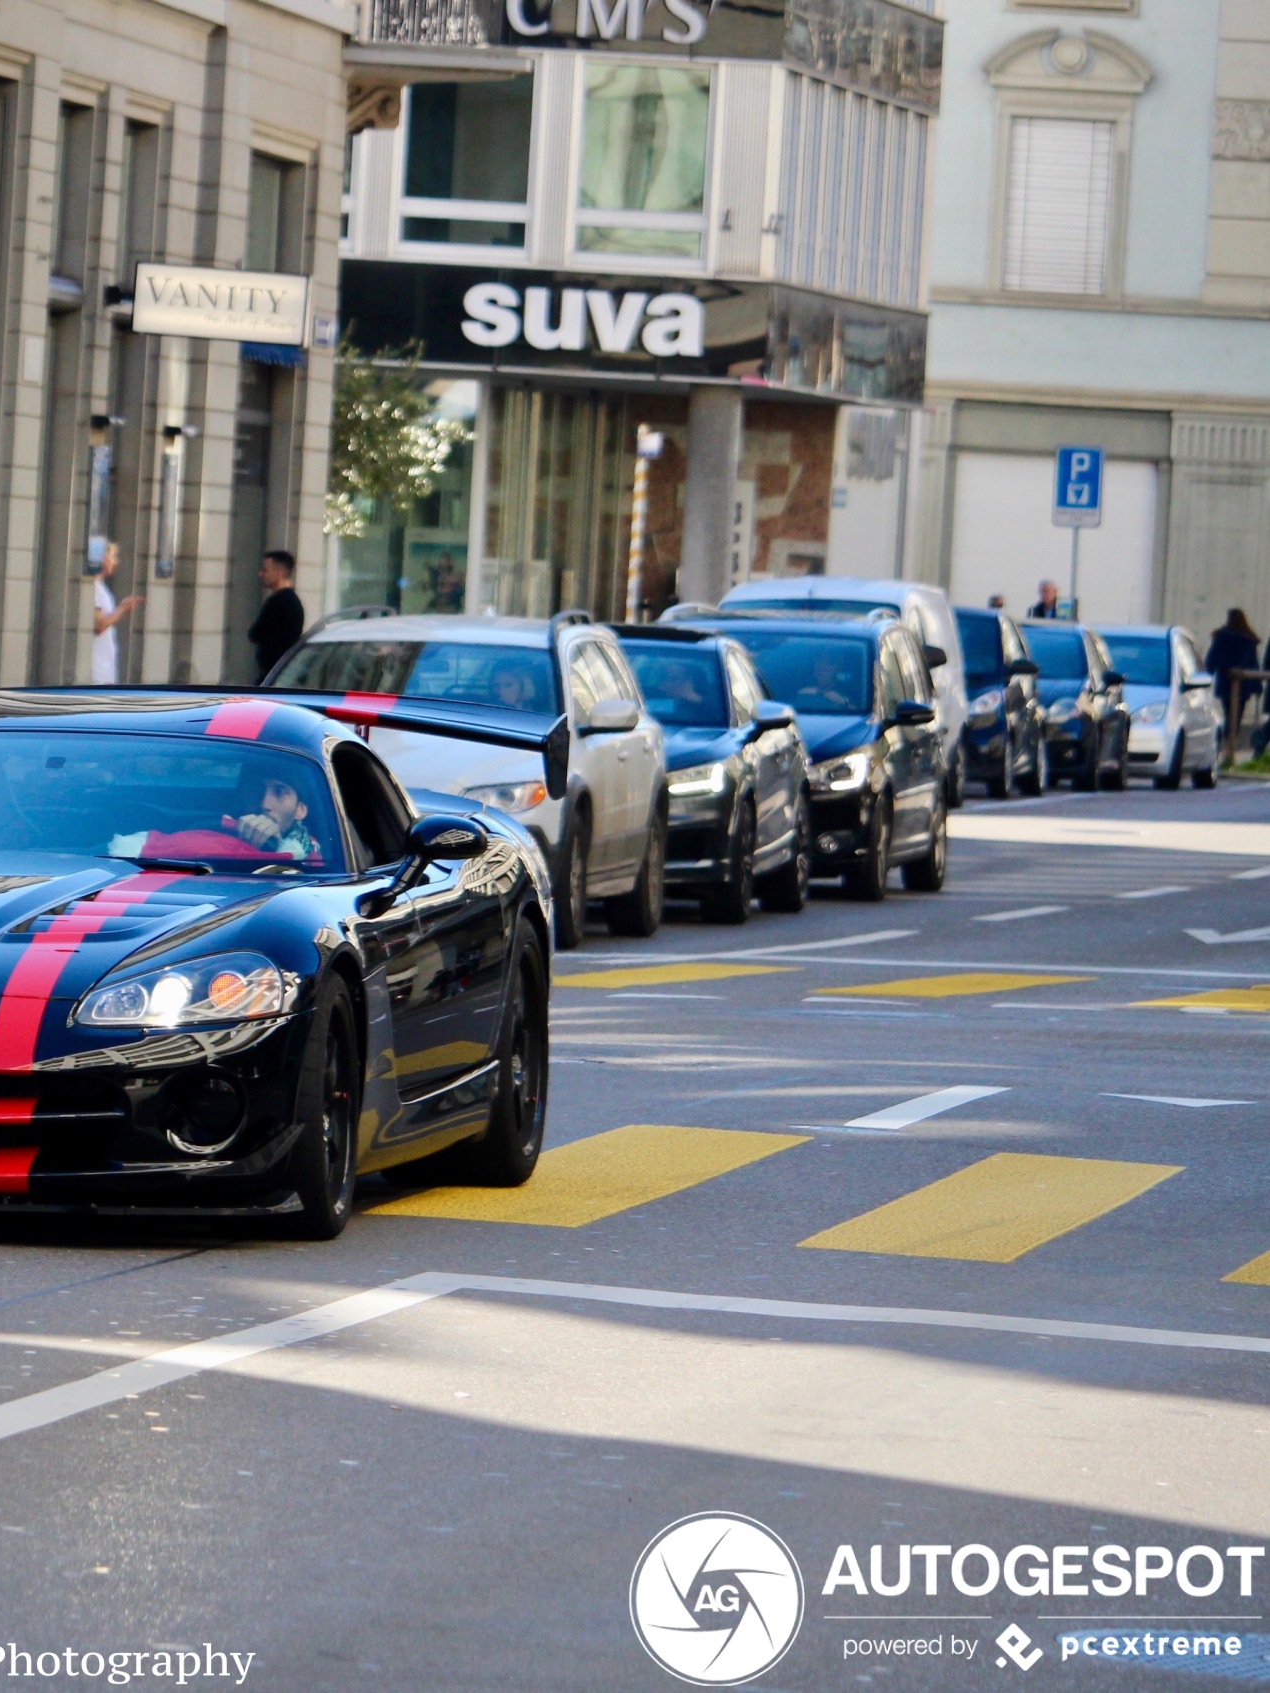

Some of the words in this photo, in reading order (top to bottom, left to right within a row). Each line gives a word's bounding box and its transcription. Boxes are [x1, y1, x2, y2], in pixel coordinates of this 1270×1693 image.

[147, 276, 287, 314] VANITY
[461, 282, 705, 357] suva
[1071, 452, 1091, 481] P
